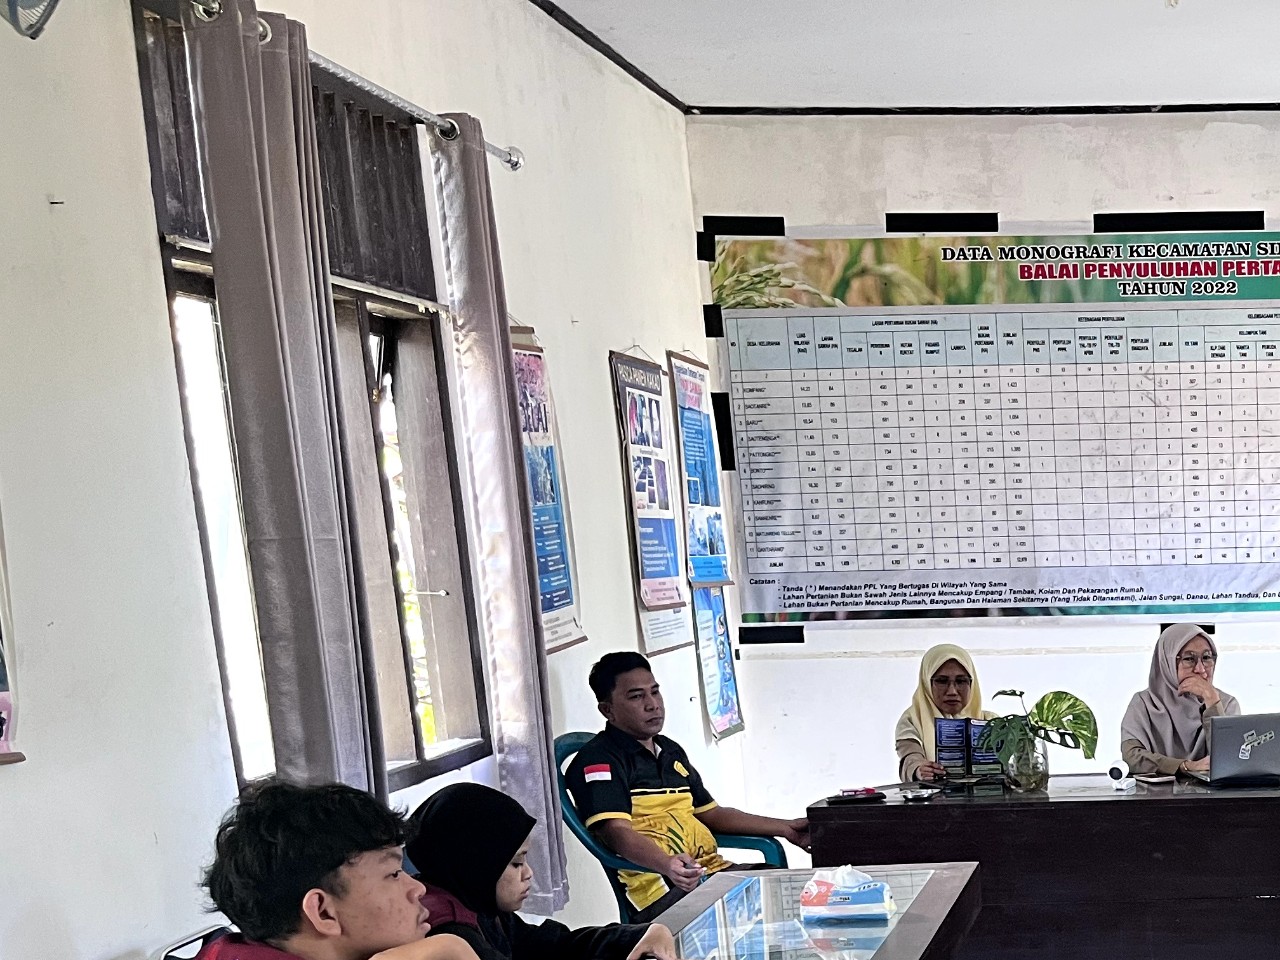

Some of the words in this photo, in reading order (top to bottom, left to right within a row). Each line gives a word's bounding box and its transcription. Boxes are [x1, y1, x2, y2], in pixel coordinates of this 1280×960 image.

[941, 246, 994, 261] DATA
[998, 245, 1123, 260] MONOGRAFI
[1127, 242, 1251, 258] KECAMATAN
[1019, 263, 1079, 280] BALAI
[1084, 261, 1217, 279] PENYULUHAN
[1118, 282, 1187, 296] TAHUN
[1191, 281, 1237, 294] 2022
[898, 582, 930, 590] Bertugas
